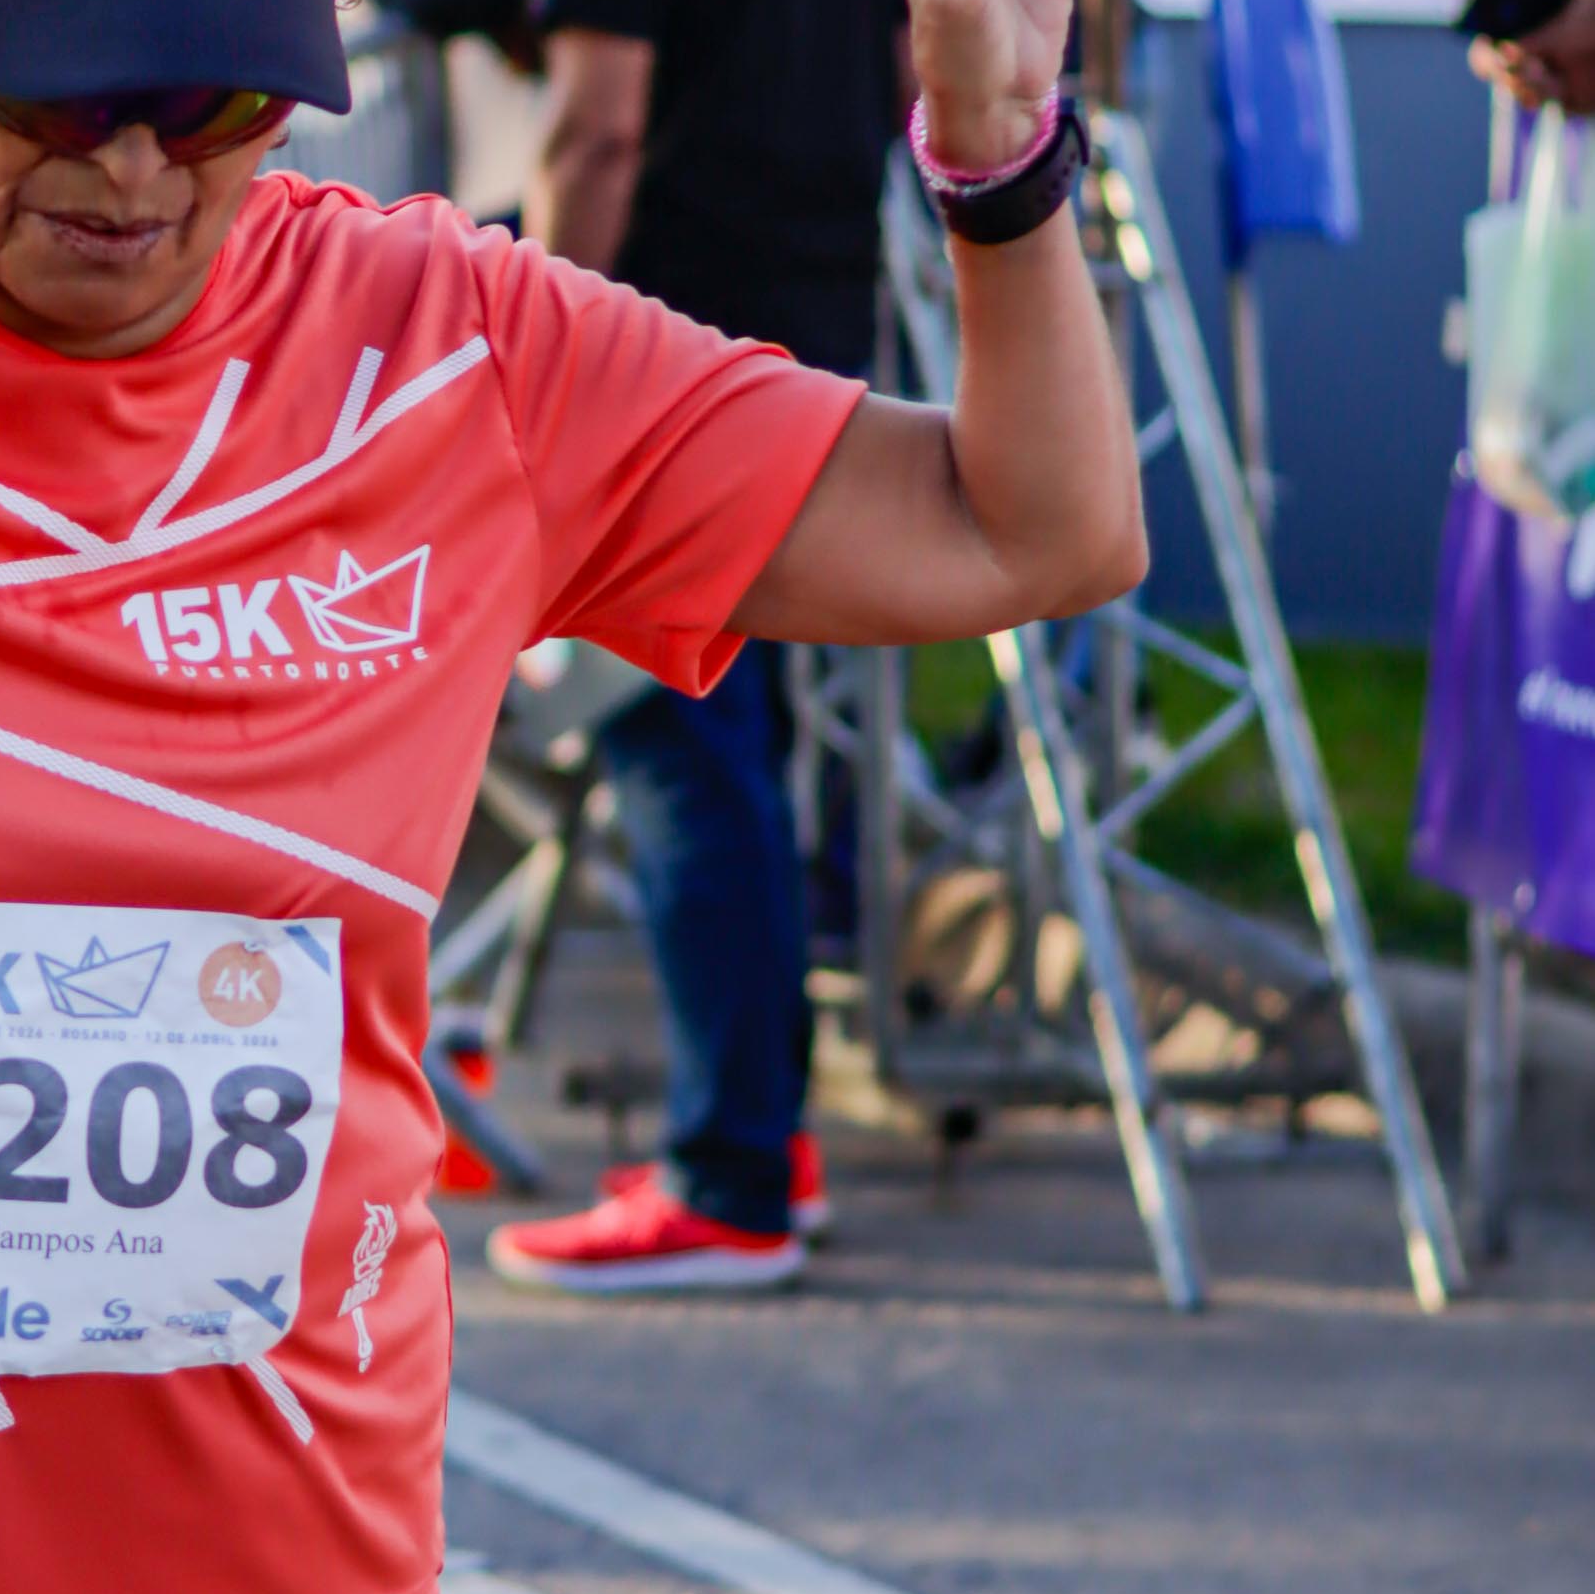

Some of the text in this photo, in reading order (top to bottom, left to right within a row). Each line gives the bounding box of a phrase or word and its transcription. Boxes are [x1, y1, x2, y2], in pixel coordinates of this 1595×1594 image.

[121, 578, 293, 663] 15K
[156, 646, 429, 681] PUERTO NORTE
[213, 965, 263, 1003] 4K
[61, 1027, 127, 1042] ROSARIO
[106, 1227, 164, 1255] Ana
